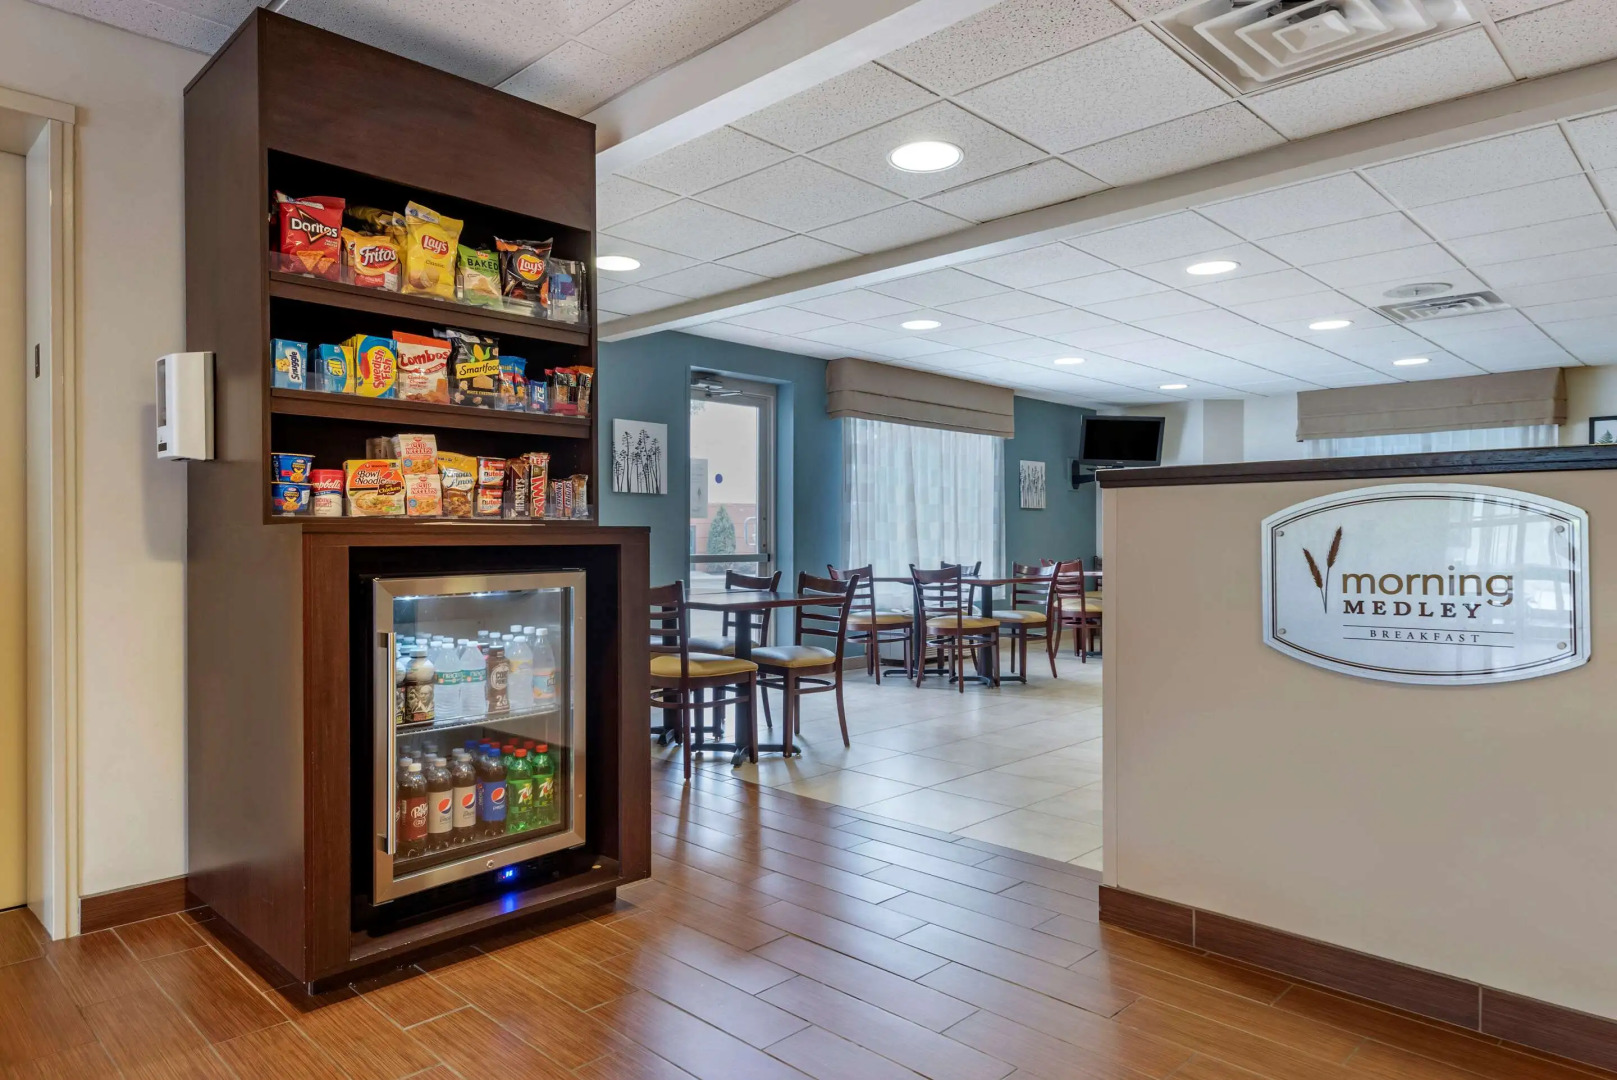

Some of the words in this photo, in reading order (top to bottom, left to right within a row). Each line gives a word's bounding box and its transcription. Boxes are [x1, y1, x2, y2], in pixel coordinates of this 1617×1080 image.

[291, 217, 338, 238] Doritos
[423, 235, 448, 254] Lay's
[359, 246, 397, 266] Fritos
[467, 257, 499, 271] BAKED
[518, 259, 545, 275] Lay's
[291, 351, 300, 380] Snuggle
[400, 350, 449, 367] Combos
[373, 349, 385, 389] Swedish
[382, 358, 393, 380] Fish
[355, 476, 386, 486] Noodle
[357, 469, 381, 478] Bowl
[530, 471, 546, 517] TWIX
[1342, 565, 1513, 607] morning
[1343, 600, 1482, 619] MEDLEY
[1370, 629, 1480, 643] BREAKFAST
